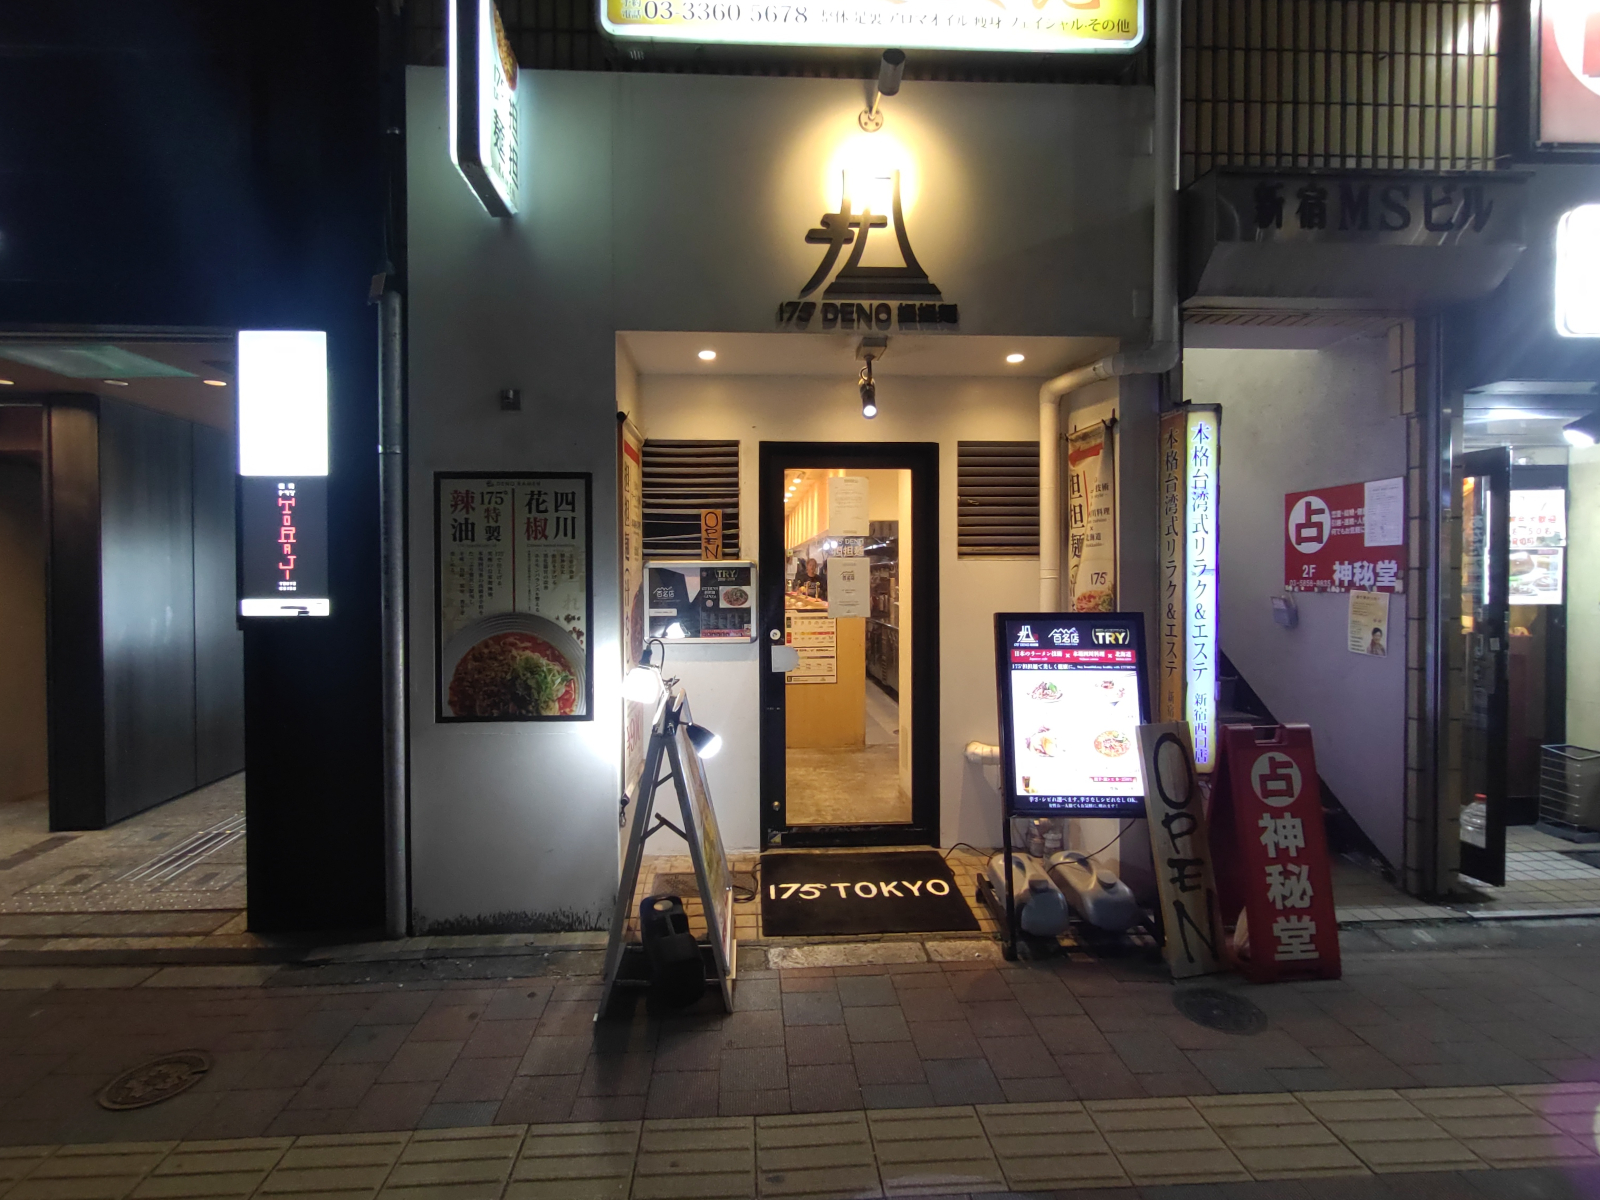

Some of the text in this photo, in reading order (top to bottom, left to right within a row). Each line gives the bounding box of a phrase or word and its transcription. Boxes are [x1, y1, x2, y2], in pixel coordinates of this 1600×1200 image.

[821, 302, 892, 323] DENO
[450, 489, 476, 543] 辣油
[524, 490, 549, 541] 花椒
[553, 491, 577, 540] 四川
[704, 512, 719, 560] OPEN
[1295, 501, 1326, 546] 占
[717, 569, 737, 578] TRY
[1302, 564, 1317, 578] 2F
[1333, 560, 1398, 587] 神秘堂
[1053, 633, 1080, 643] 百名店
[1096, 632, 1126, 645] TRY
[1194, 692, 1208, 764] 新宿西口店
[1258, 756, 1295, 800] 占
[1153, 732, 1219, 964] OPEN
[831, 879, 950, 899] TOKYO
[1258, 812, 1320, 961] 神秘堂
